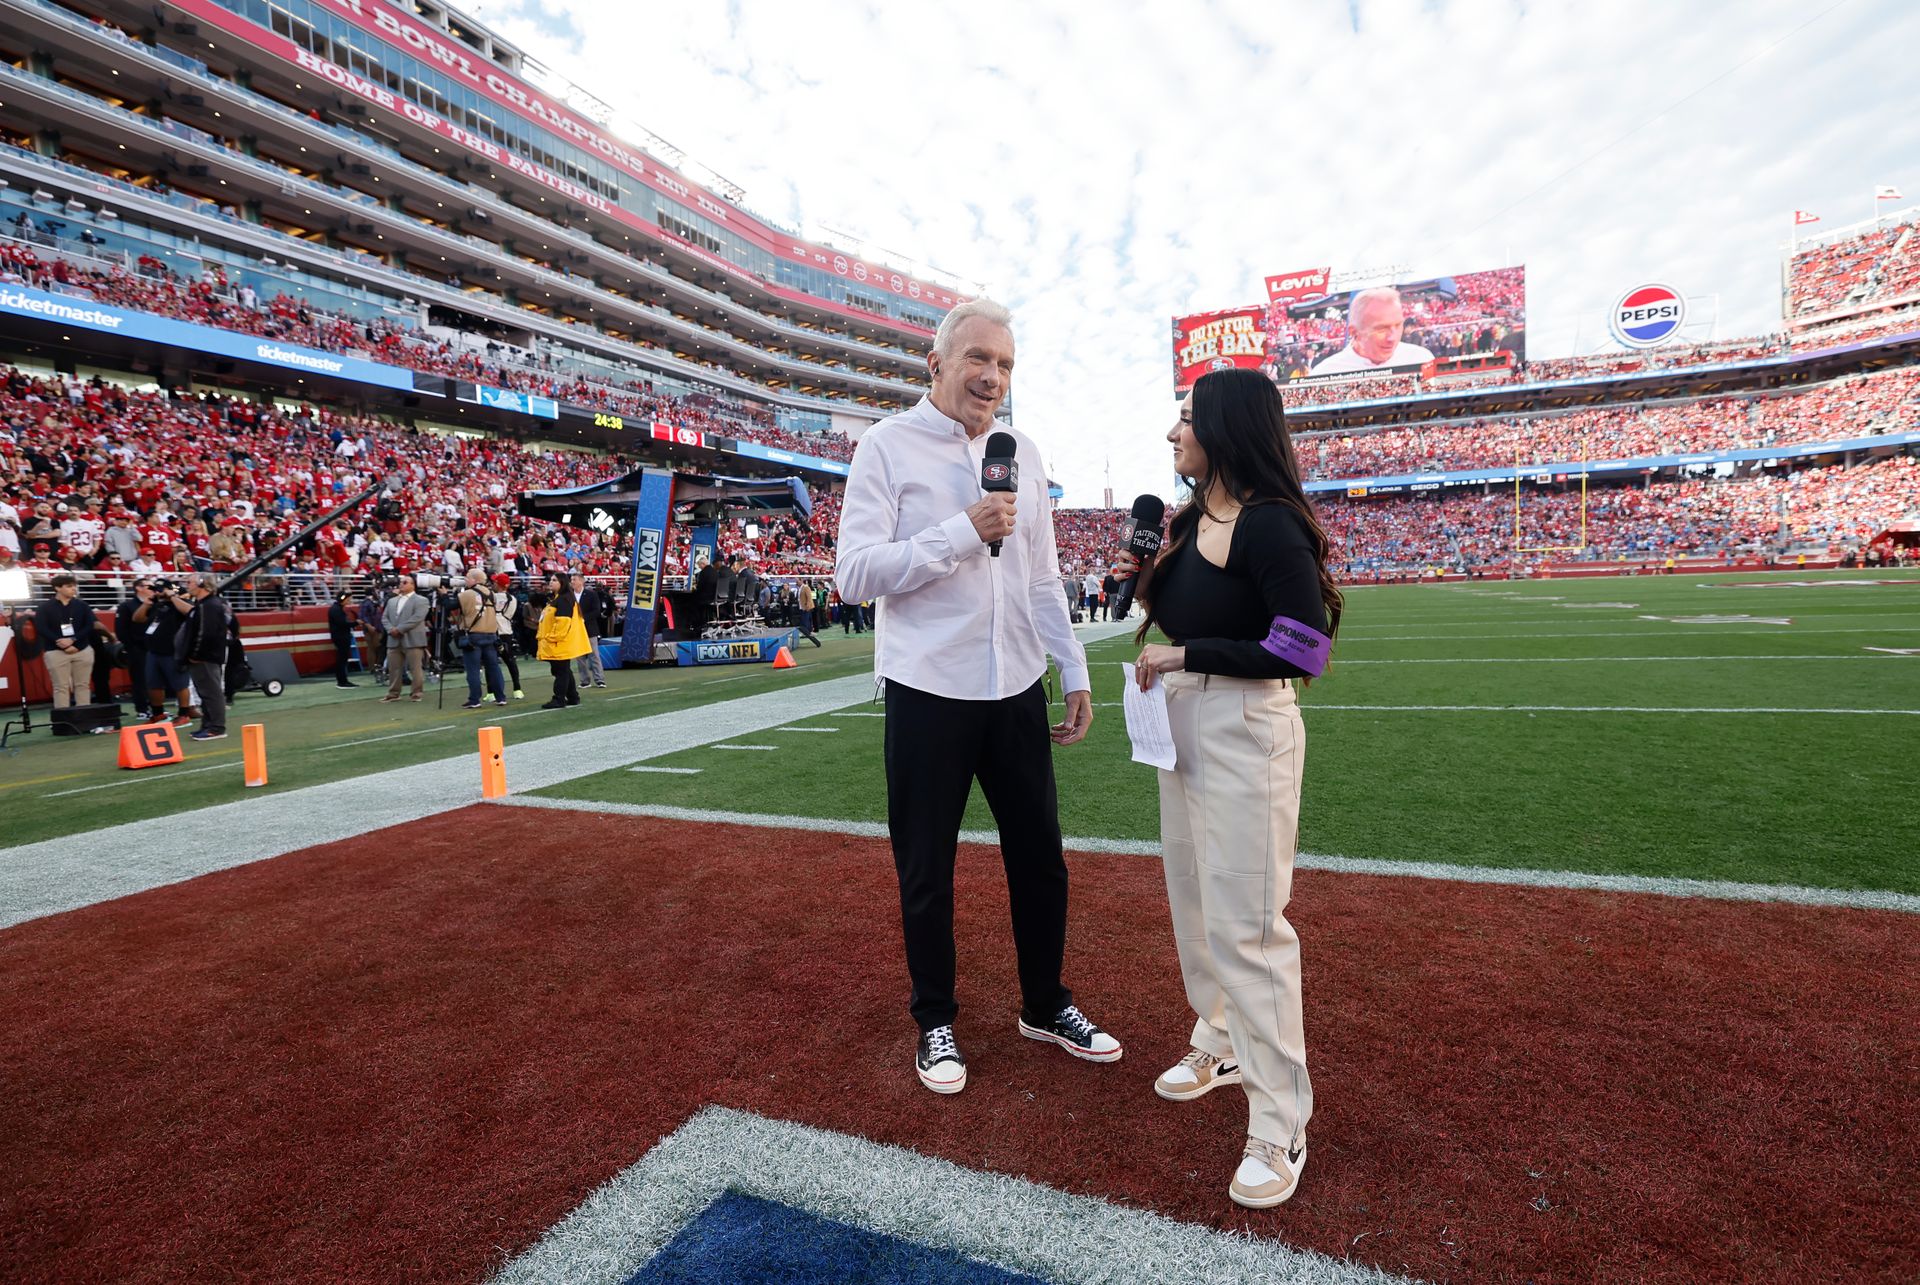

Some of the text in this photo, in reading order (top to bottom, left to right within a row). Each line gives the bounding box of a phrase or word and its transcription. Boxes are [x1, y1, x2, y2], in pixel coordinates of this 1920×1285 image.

[372, 6, 480, 82] BOWL
[486, 74, 644, 174] CHAMPIONS
[295, 48, 611, 214] HOME OF THE FAITHFUL
[0, 290, 122, 328] icketmaster
[1621, 305, 1678, 322] PEPSI
[1189, 325, 1206, 345] DO
[1206, 319, 1223, 338] IT
[1223, 316, 1255, 334] FOR
[257, 344, 343, 372] ticketmaster
[1180, 331, 1267, 367] THE BAY
[594, 413, 623, 430] 24:38
[1410, 483, 1440, 491] GEICO
[70, 531, 91, 546] 23
[147, 530, 169, 545] 23
[1132, 538, 1146, 547] THE
[1145, 541, 1159, 551] BAY
[1134, 529, 1161, 544] FAITHFUL
[634, 530, 659, 606] FOX NFL
[699, 644, 758, 660] FOX NFL
[136, 727, 174, 761] G
